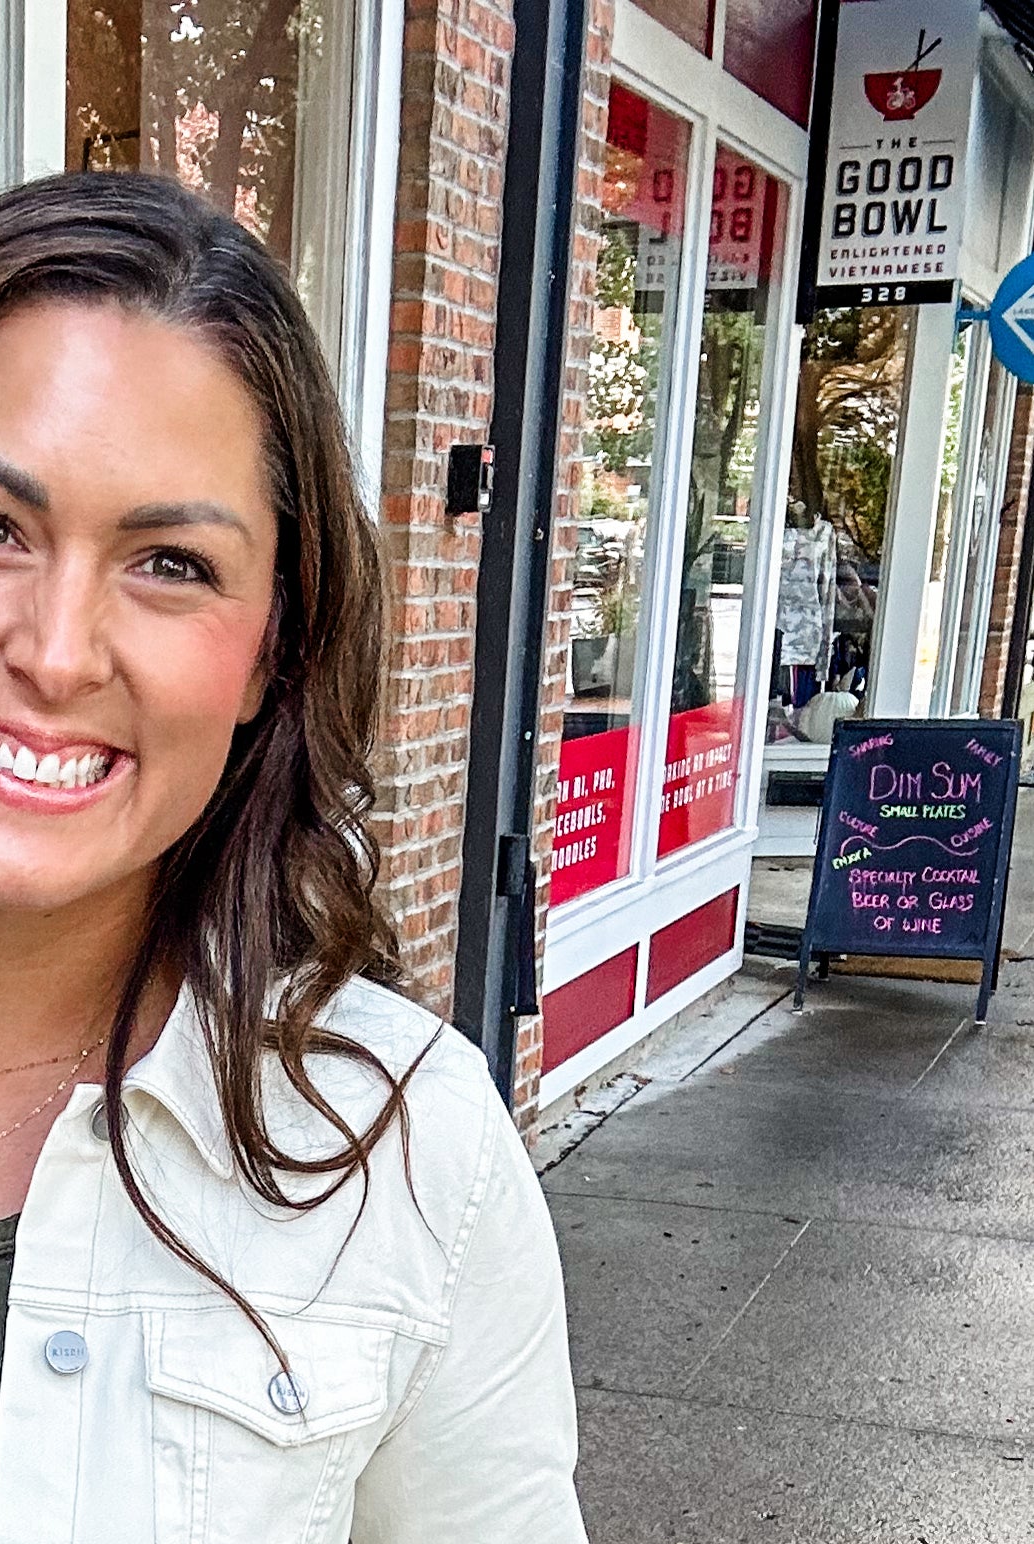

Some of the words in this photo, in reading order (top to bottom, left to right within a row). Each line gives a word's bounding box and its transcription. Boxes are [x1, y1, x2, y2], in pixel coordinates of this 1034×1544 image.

[876, 137, 917, 149] THE
[836, 155, 953, 196] GOOD
[831, 198, 948, 239] BOWL
[830, 244, 946, 260] ENLIGHTENED
[829, 262, 945, 278] VIETNAMESE
[861, 286, 906, 302] 328
[869, 764, 922, 801] DIM
[931, 761, 982, 803] SUM
[879, 804, 918, 818] SMALL
[923, 804, 966, 819] PLATES
[849, 868, 916, 885] SPECIALTY
[922, 866, 981, 884] COCKTAIL
[852, 891, 889, 909] BEER
[897, 895, 918, 909] OR
[929, 891, 974, 912] GLASS
[874, 915, 895, 931] OF
[903, 917, 942, 934] WINE
